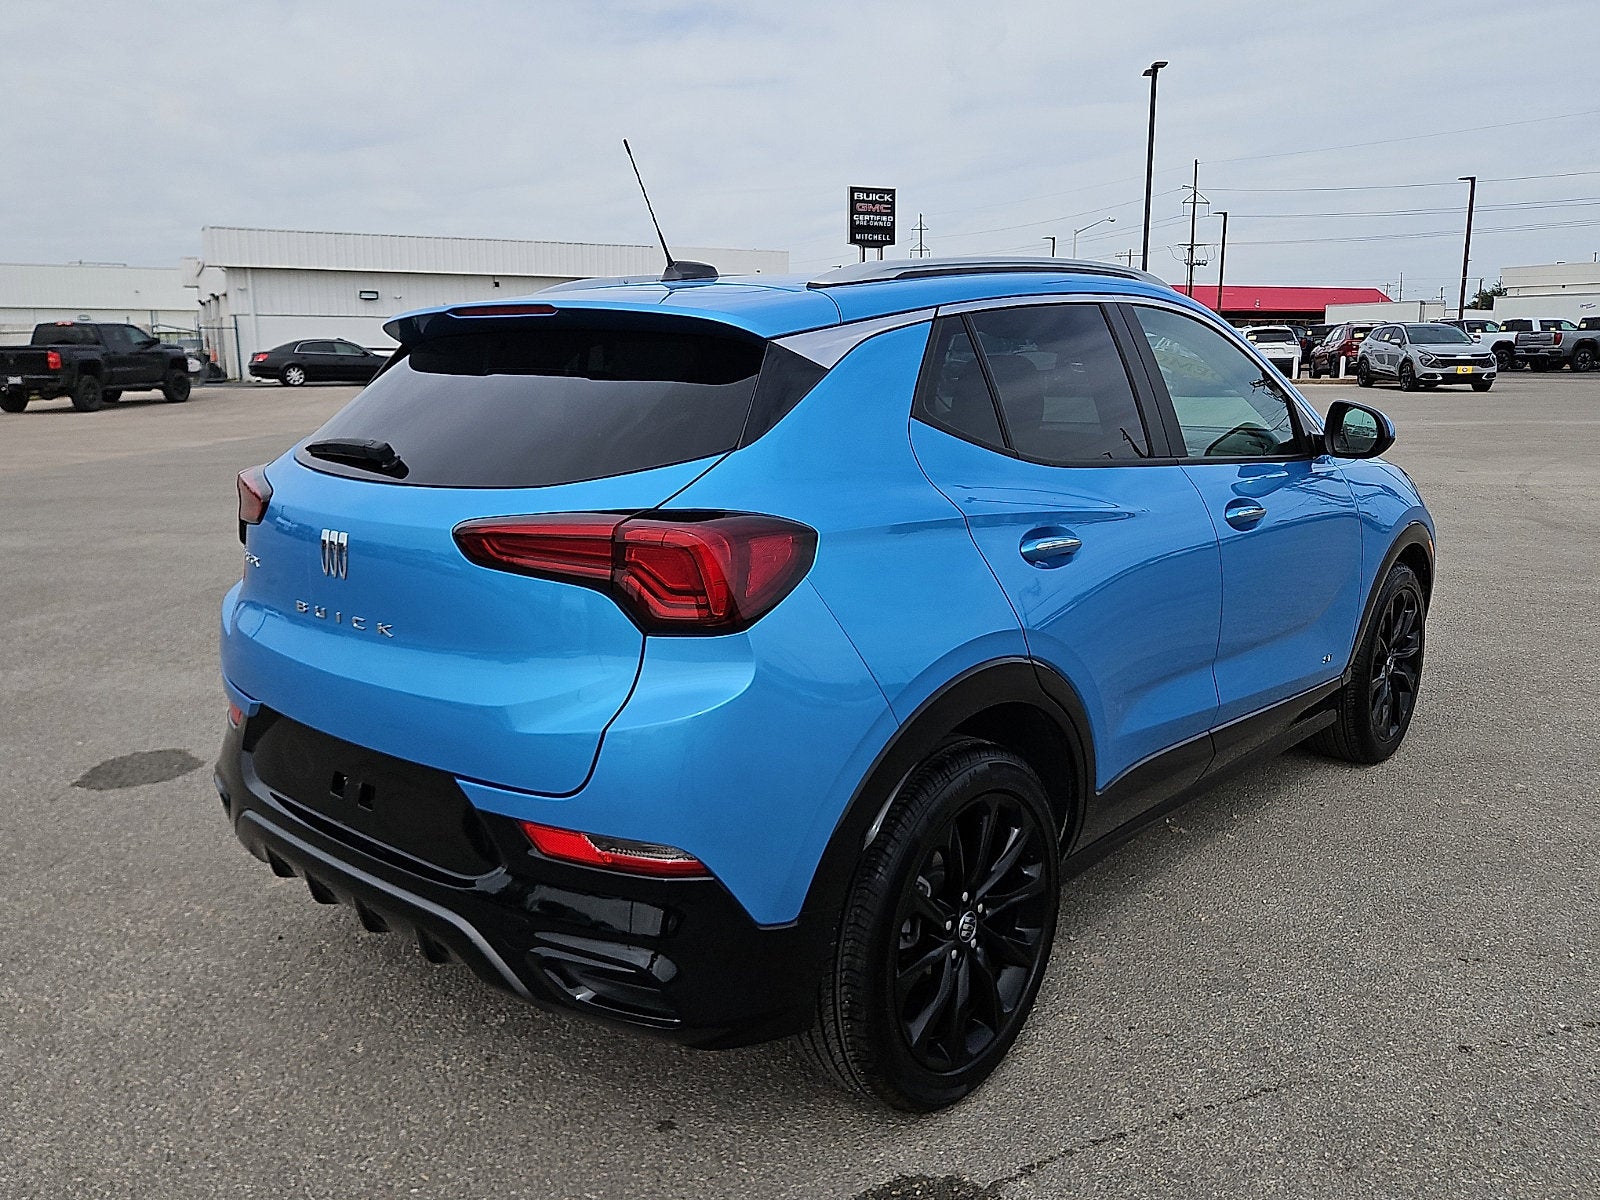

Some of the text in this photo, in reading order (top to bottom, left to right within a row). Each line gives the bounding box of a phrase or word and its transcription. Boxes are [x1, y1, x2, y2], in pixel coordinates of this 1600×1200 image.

[854, 192, 893, 201] BUICK
[855, 203, 891, 212] GMC
[296, 599, 394, 638] BUICK
